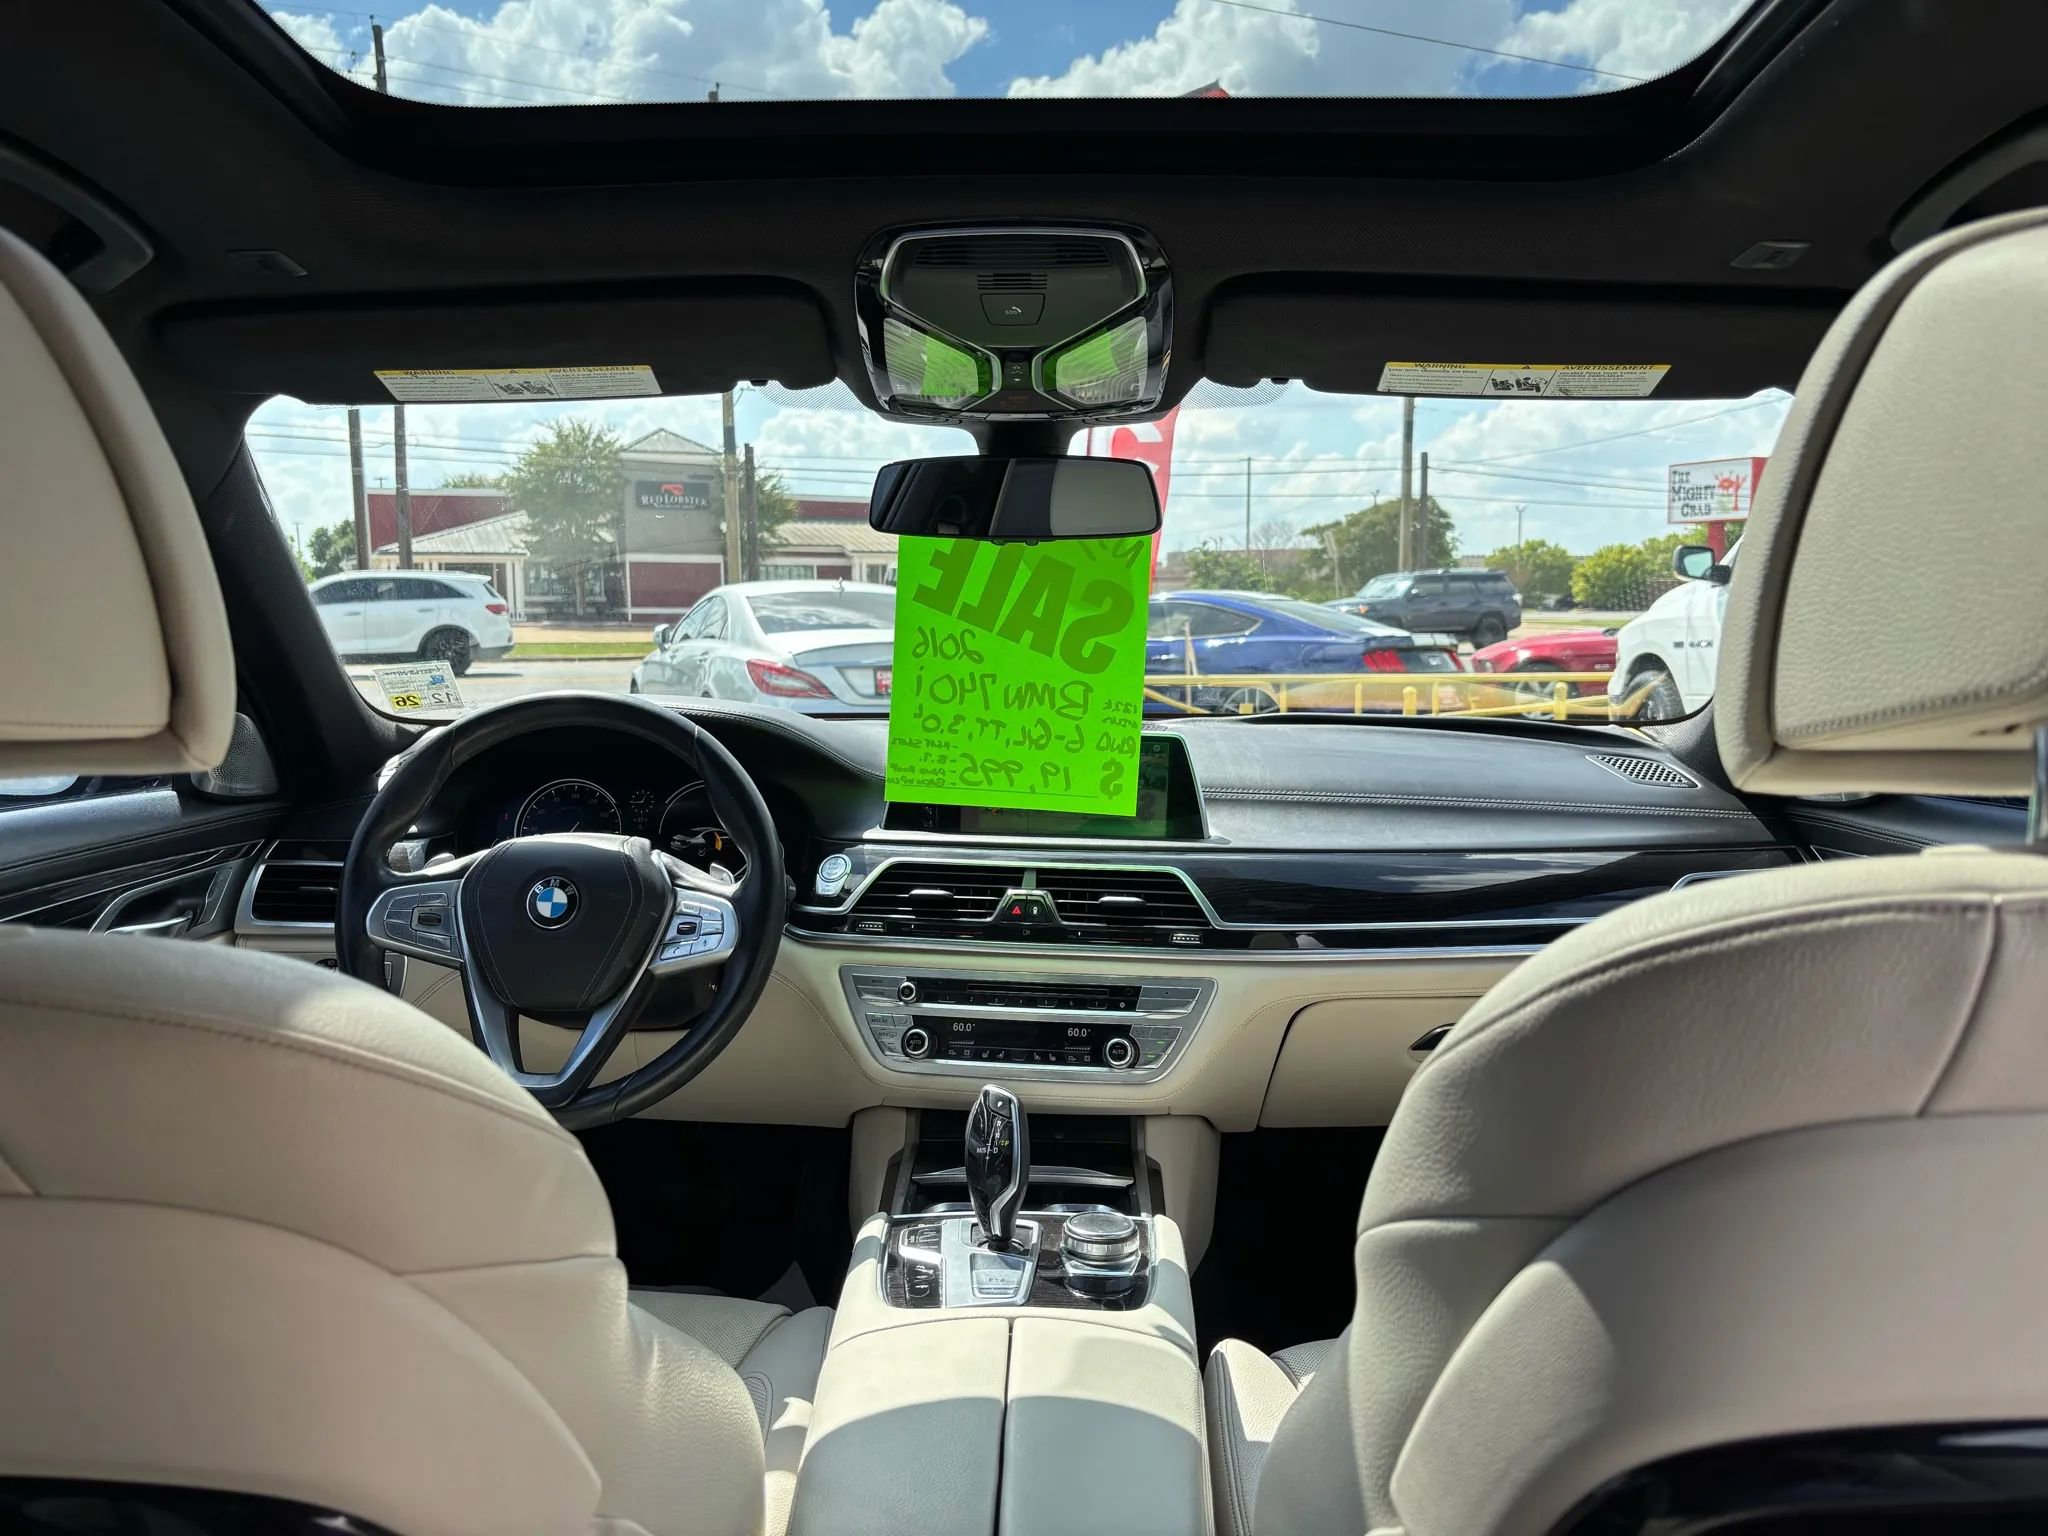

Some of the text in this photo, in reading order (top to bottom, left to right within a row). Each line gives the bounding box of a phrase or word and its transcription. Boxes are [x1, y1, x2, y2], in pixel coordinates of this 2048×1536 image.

[1671, 485, 1716, 502] MIGHTY
[1680, 502, 1712, 518] CRAB
[534, 878, 575, 896] BMW
